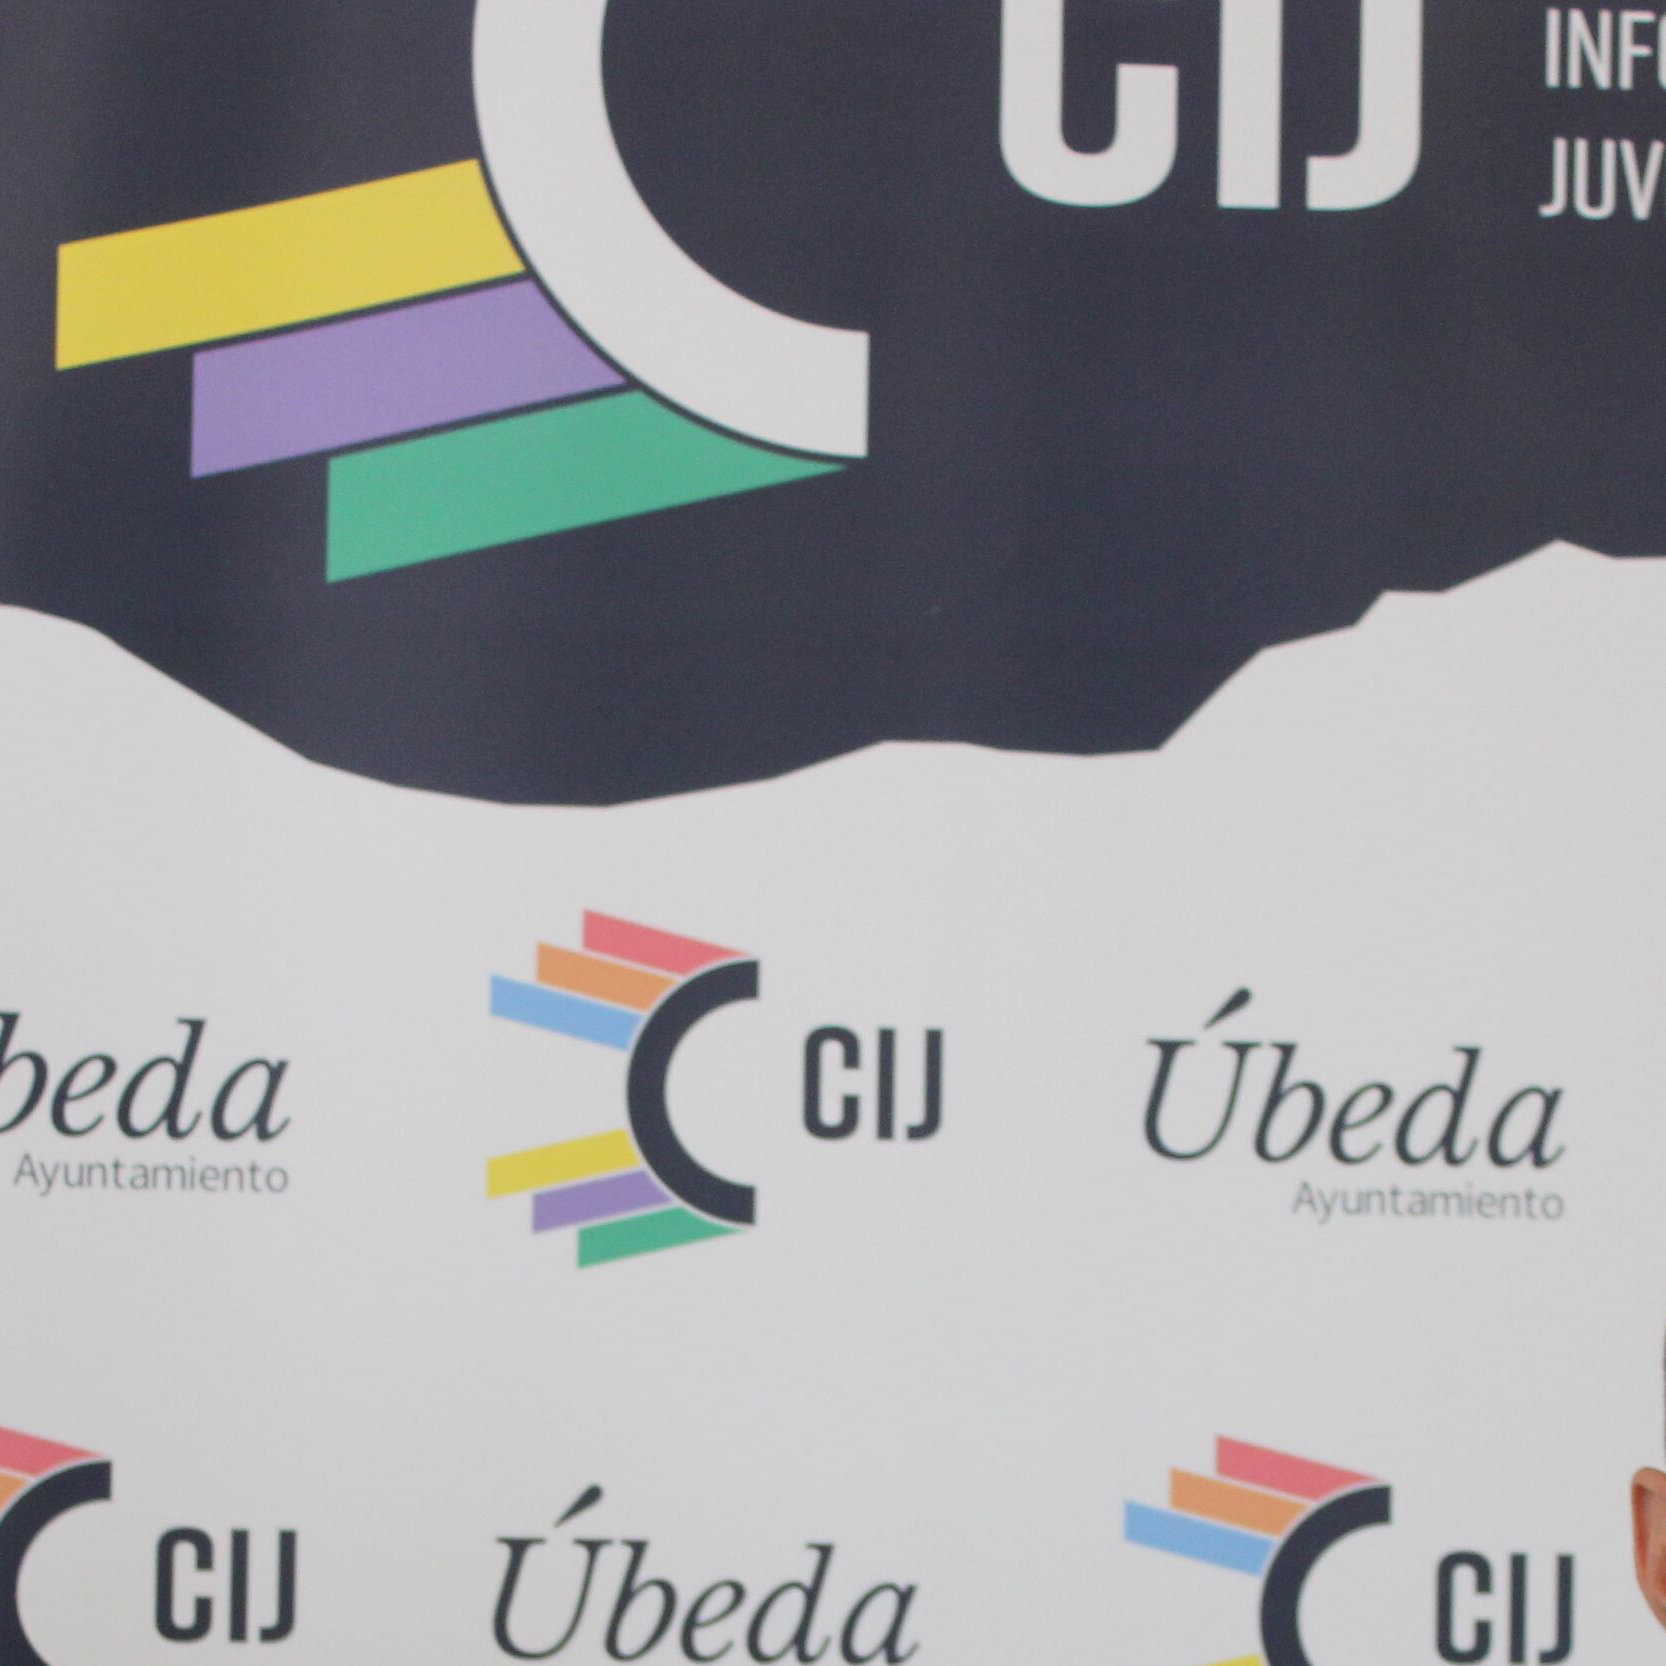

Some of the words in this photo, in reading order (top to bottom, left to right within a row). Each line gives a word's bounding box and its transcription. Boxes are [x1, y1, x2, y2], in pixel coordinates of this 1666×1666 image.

[801, 1025, 945, 1142] CIJ
[1142, 987, 1566, 1168] Úbeda
[13, 1152, 290, 1196] Ayuntamiento
[1291, 1179, 1565, 1223] Ayuntamiento
[153, 1527, 299, 1644] CIJ
[492, 1484, 920, 1666] Úbeda
[1433, 1549, 1576, 1666] CIJ
